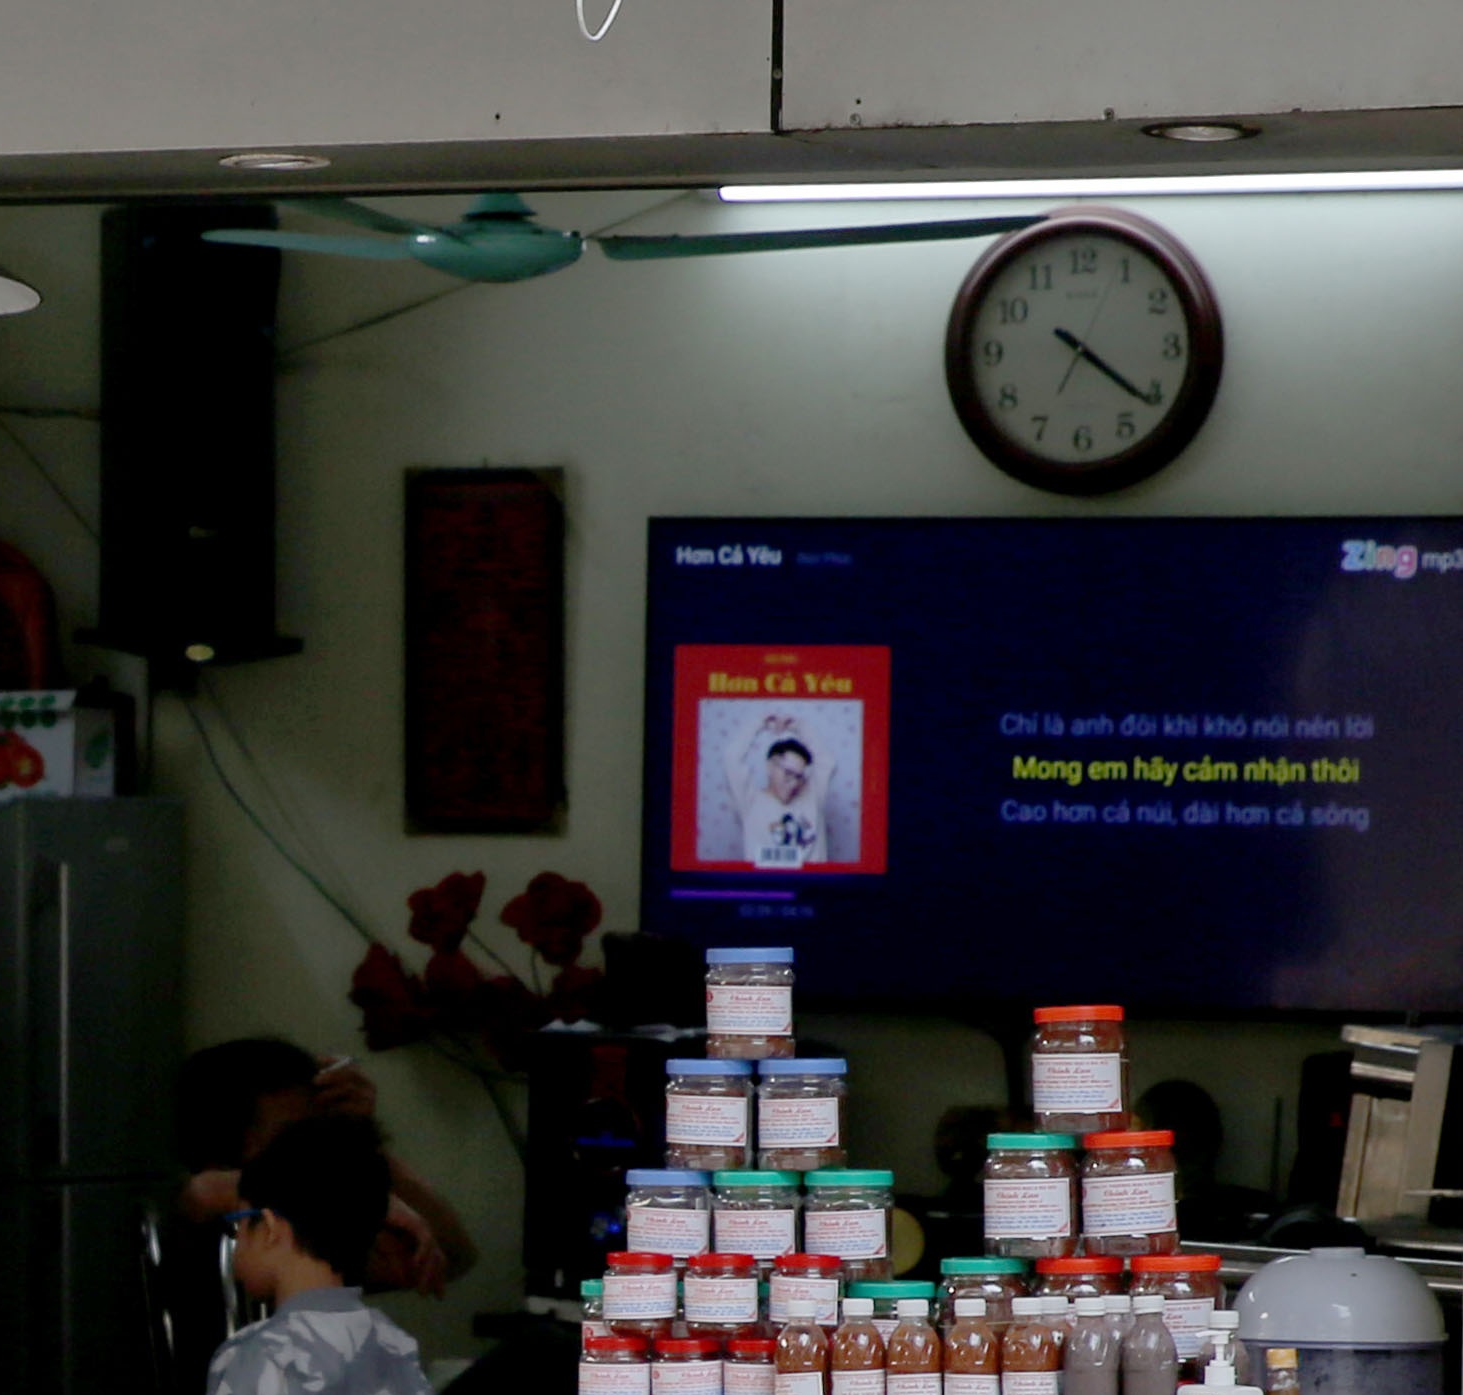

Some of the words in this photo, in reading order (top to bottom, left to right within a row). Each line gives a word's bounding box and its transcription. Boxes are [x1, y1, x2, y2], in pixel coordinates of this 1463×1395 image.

[1071, 248, 1097, 275] 12
[1030, 264, 1054, 290] 11
[998, 297, 1028, 325] 10
[1148, 288, 1168, 314] 2
[983, 339, 1003, 365] 9
[1163, 332, 1181, 359] 3
[998, 382, 1018, 408] 8
[1031, 415, 1048, 441] 7
[1116, 411, 1135, 438] 5
[1073, 425, 1092, 451] 6
[1341, 540, 1418, 578] Zing
[1044, 713, 1064, 736] là
[1070, 713, 1113, 736] anh
[1163, 713, 1198, 737] khi
[1013, 756, 1082, 785] Mong
[1088, 761, 1127, 780] em
[1133, 756, 1177, 786] hãy
[1183, 755, 1237, 781] cảm
[1244, 757, 1305, 785] nhận
[1312, 758, 1360, 782] thôi
[1001, 800, 1046, 822] Cao
[1053, 801, 1096, 823] hơn
[1225, 802, 1270, 824] hơn
[1311, 803, 1369, 831] sông
